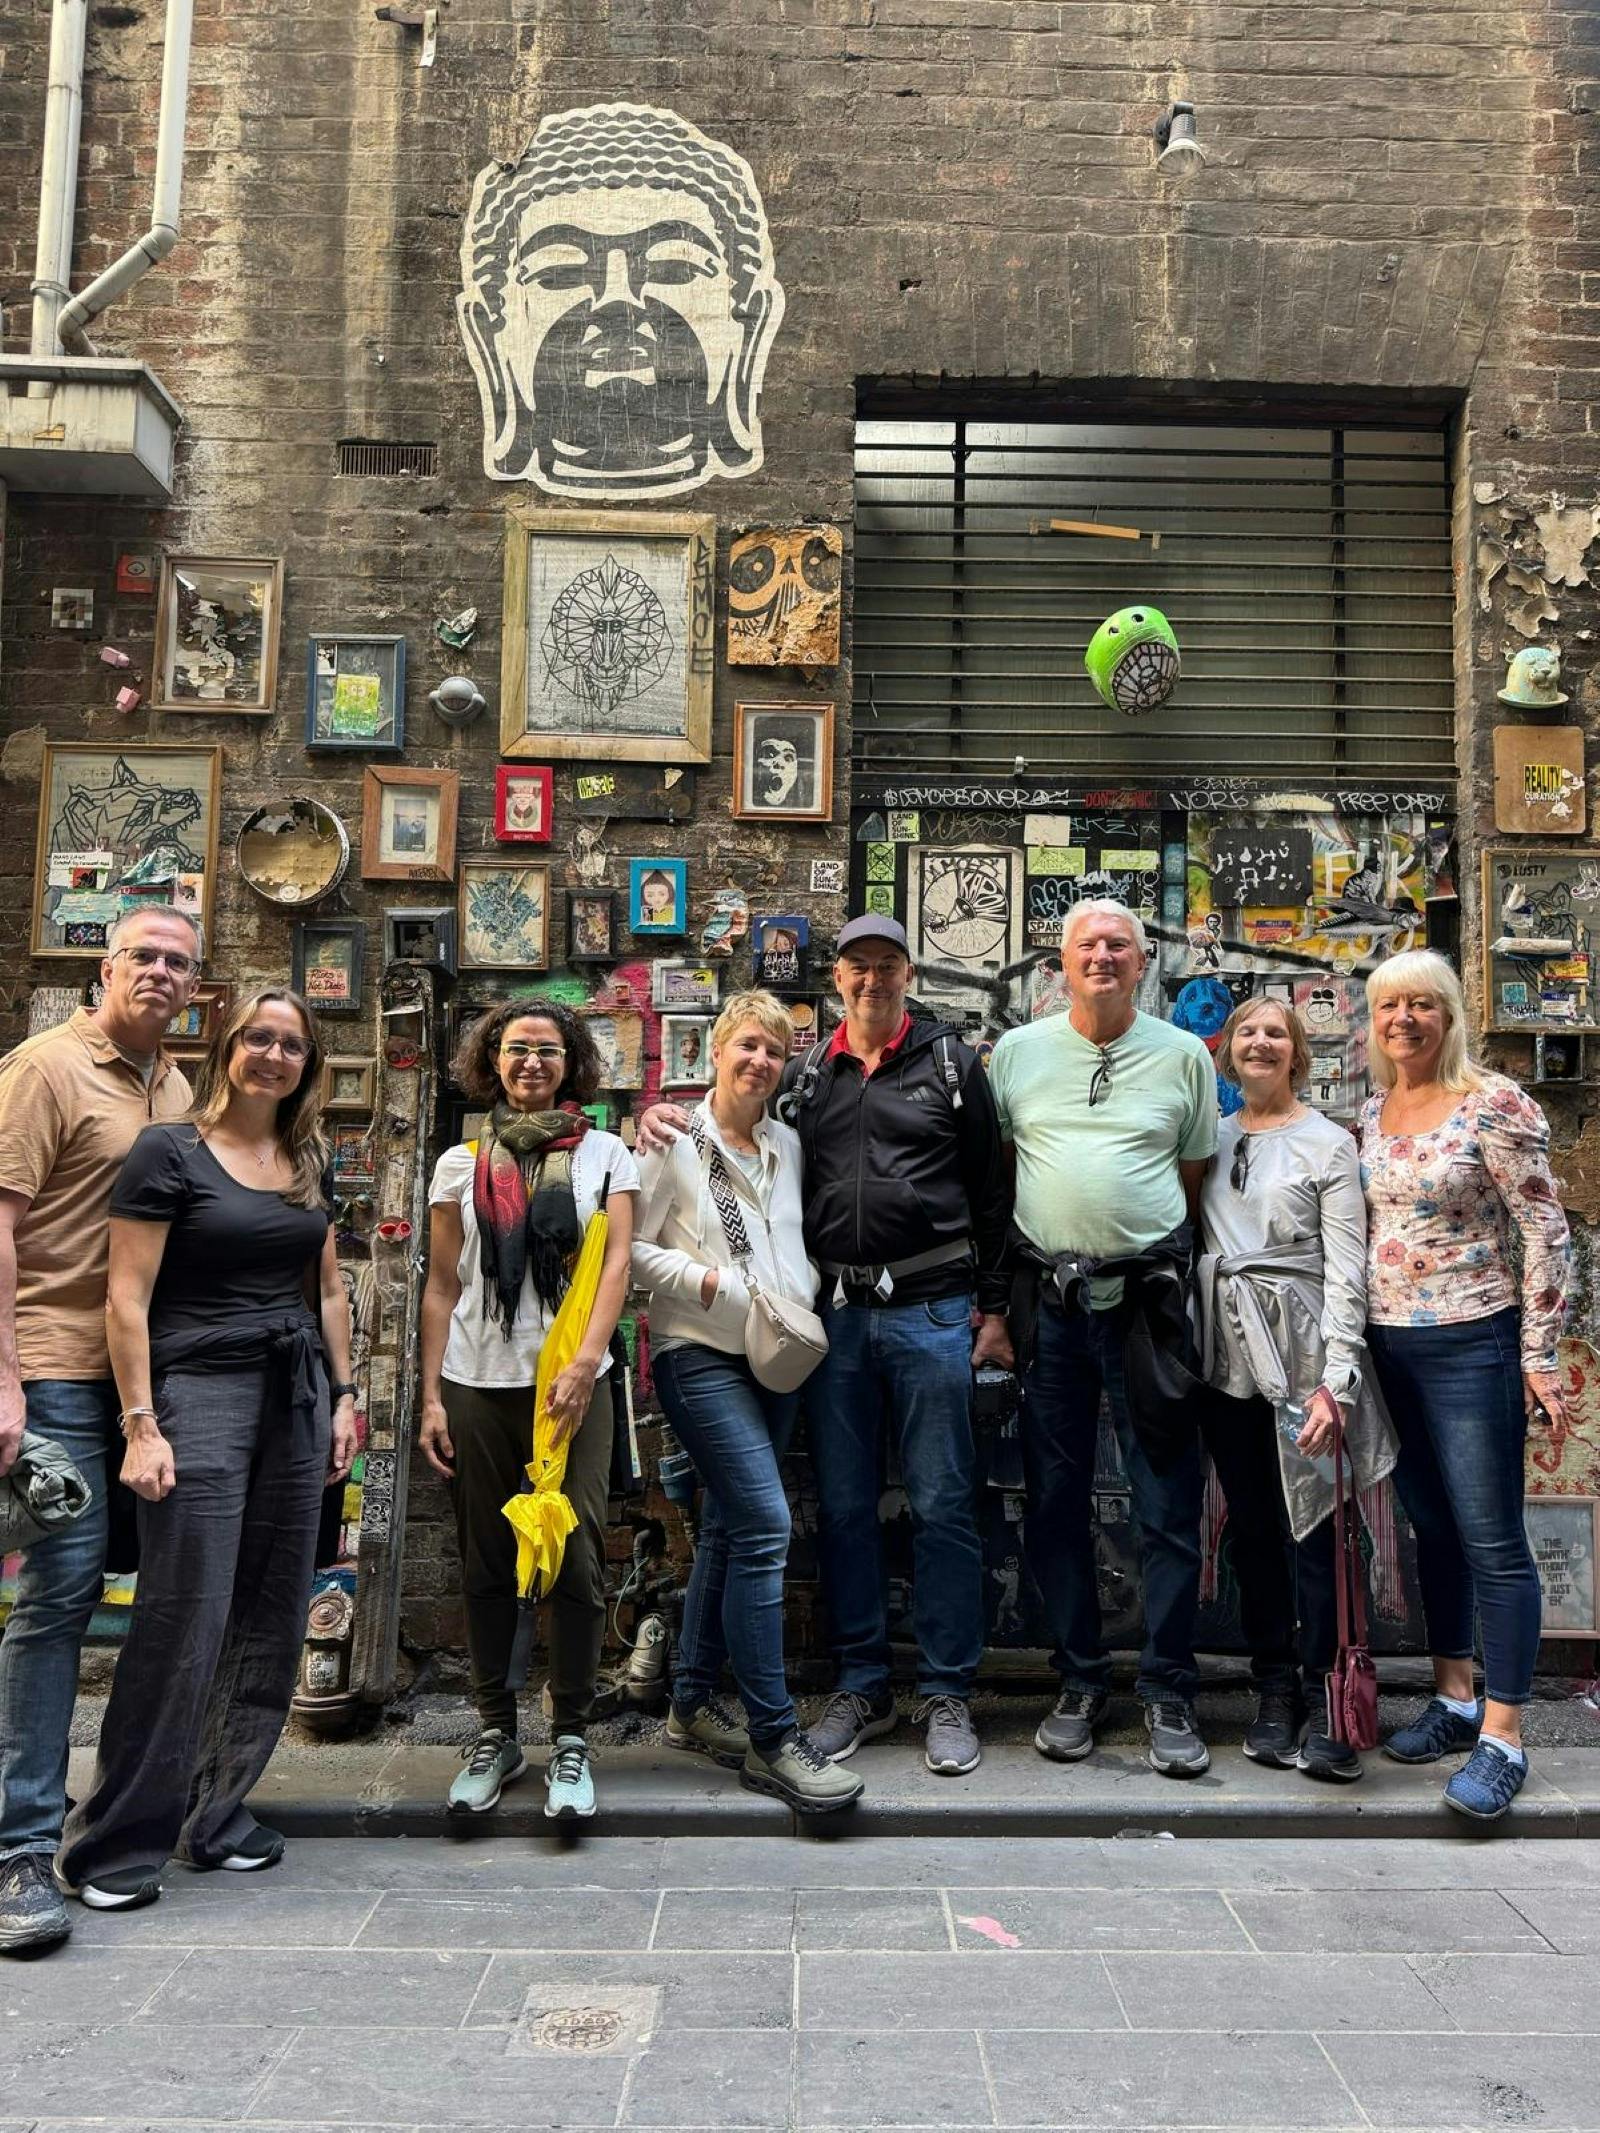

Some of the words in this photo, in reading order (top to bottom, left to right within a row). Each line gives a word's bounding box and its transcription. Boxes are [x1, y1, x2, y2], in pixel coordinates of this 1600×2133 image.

[1524, 765, 1562, 793] REALITY
[814, 861, 839, 870] LAND
[813, 869, 827, 877] OF
[1512, 864, 1546, 877] LUSTY
[813, 882, 839, 891] SHINE
[309, 1654, 335, 1663] LAND
